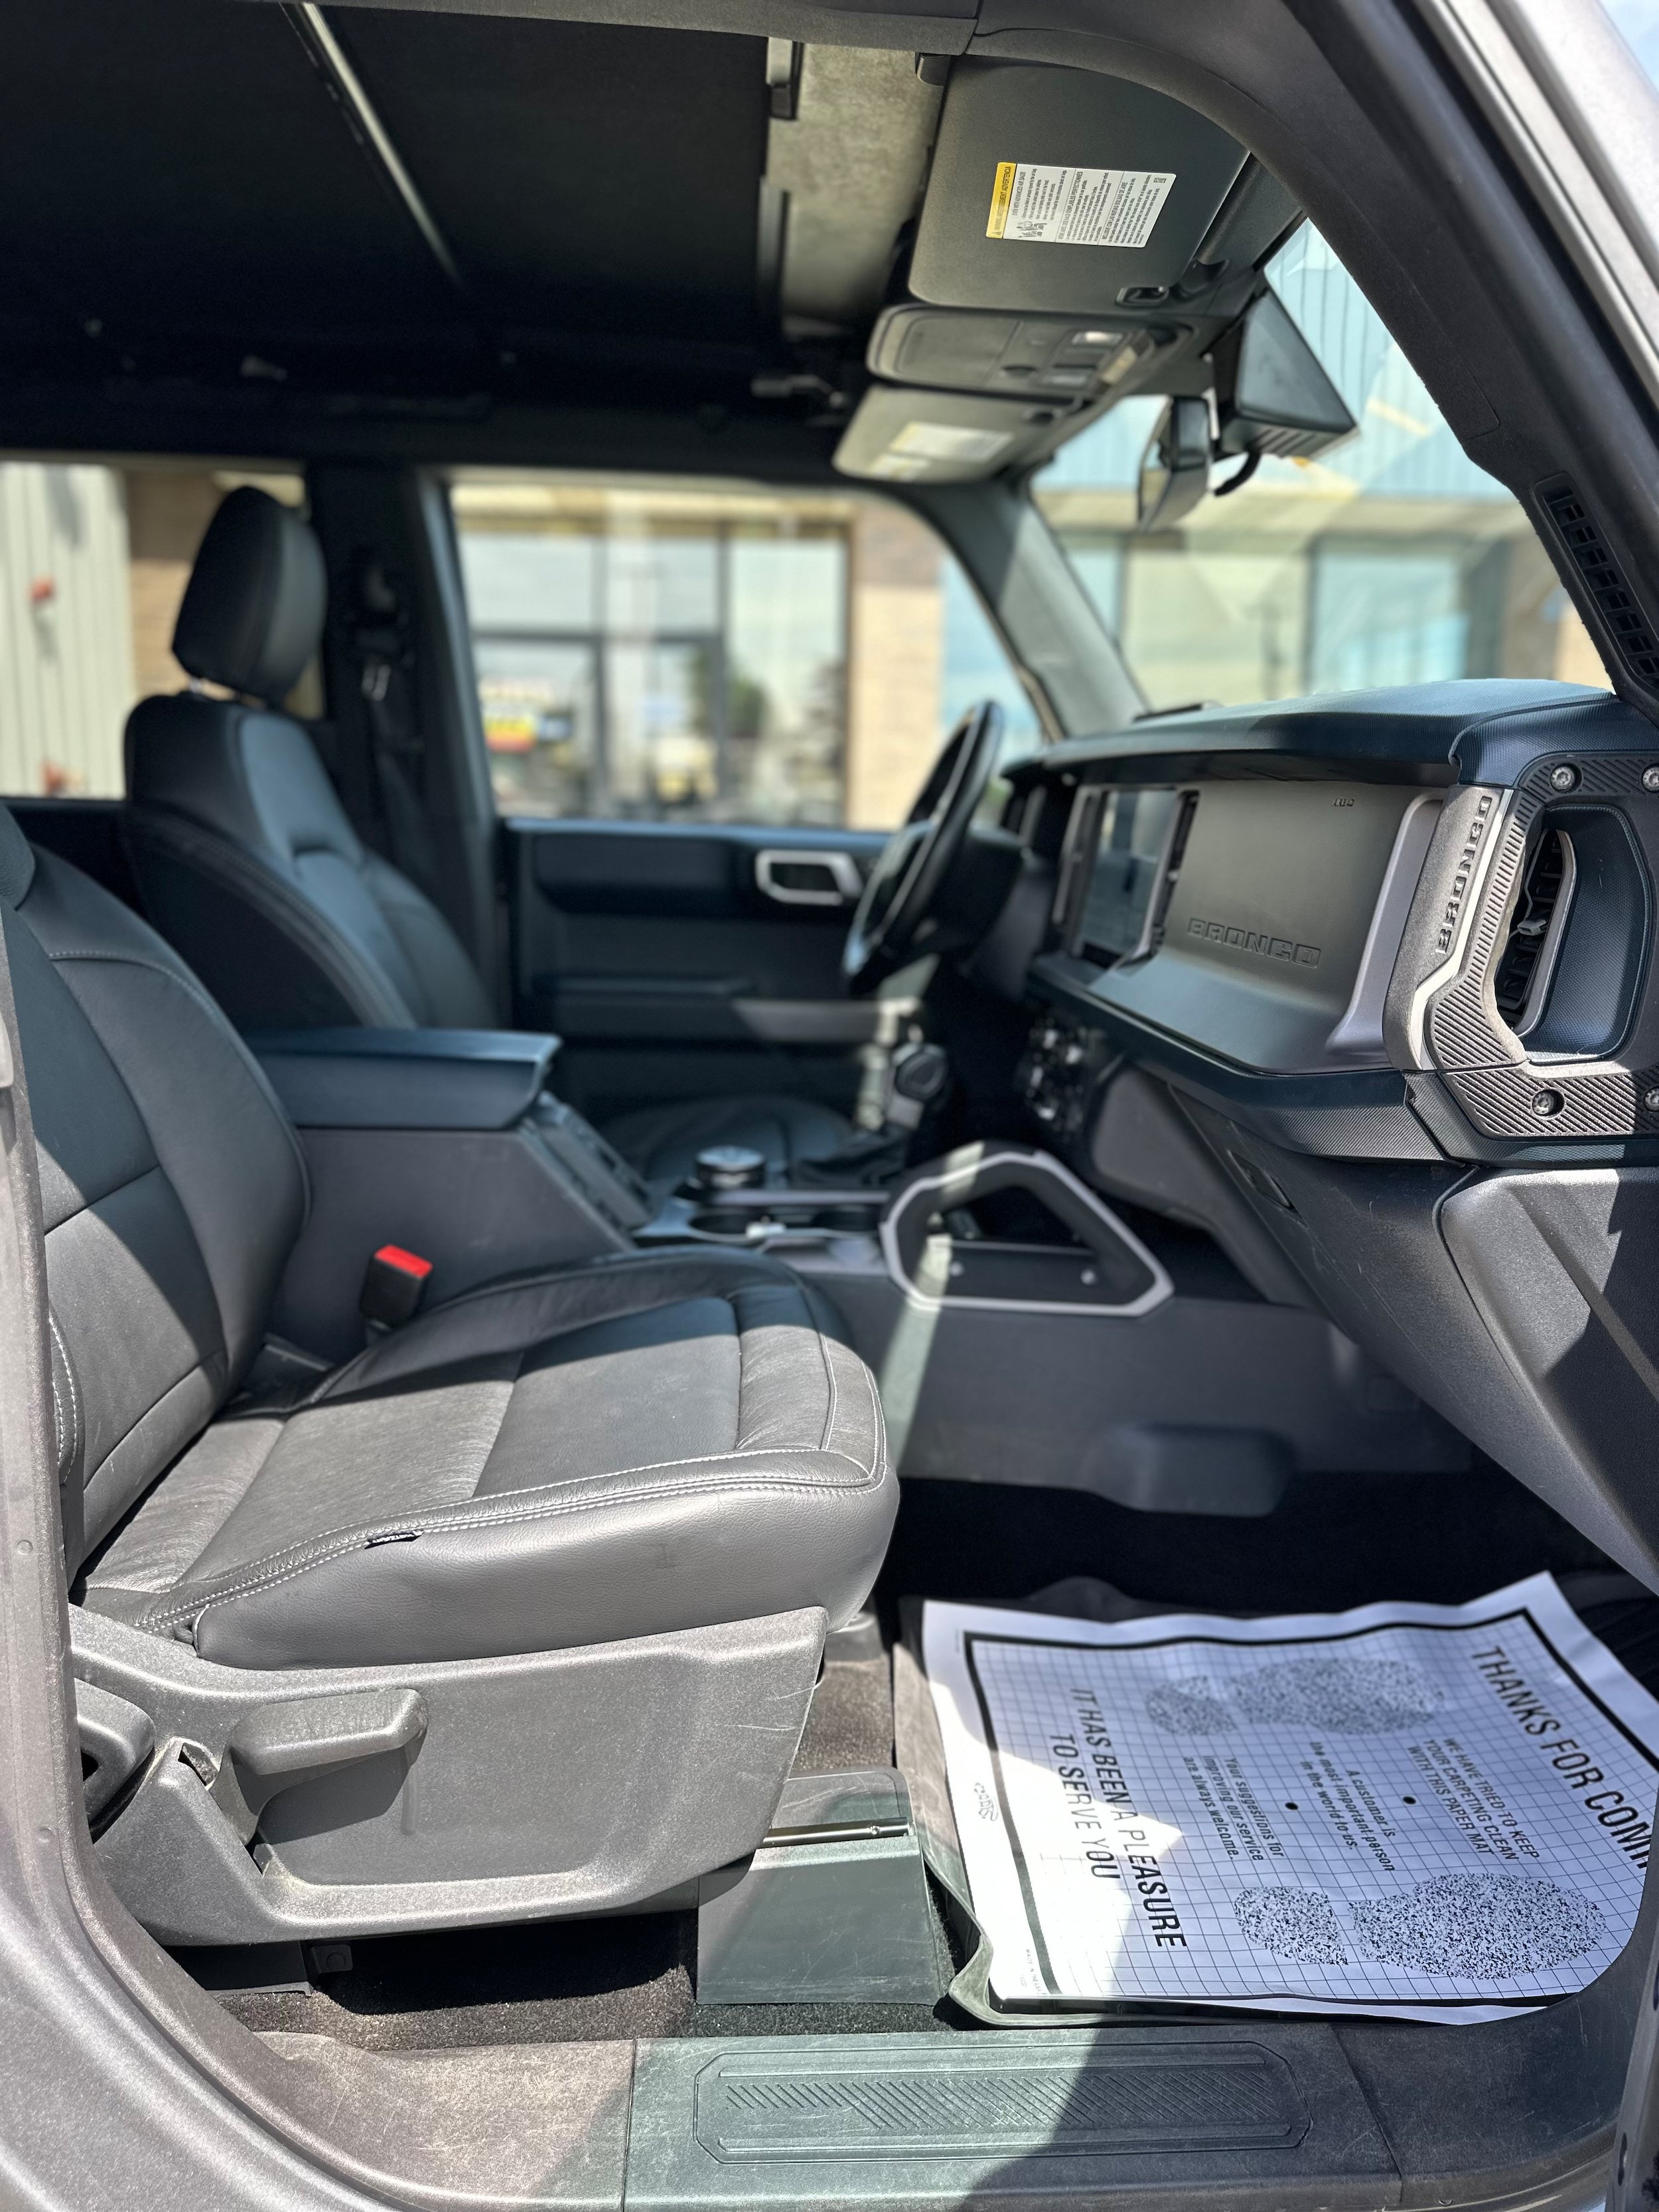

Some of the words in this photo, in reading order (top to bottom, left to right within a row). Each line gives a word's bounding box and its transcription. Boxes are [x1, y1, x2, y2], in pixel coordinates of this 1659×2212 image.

[1435, 796, 1492, 954] BRONCO
[1187, 917, 1321, 969] BRONCO
[1070, 1688, 1098, 1705] IT
[1050, 1733, 1080, 1757] TO
[1078, 1709, 1112, 1747] HAS
[1443, 1738, 1465, 1753] WE
[1091, 1753, 1133, 1803] BEEN
[1453, 1755, 1484, 1779] HAVE
[1471, 1646, 1561, 1735] THANKS
[1540, 1739, 1605, 1790] FOR
[1584, 1791, 1652, 1869] COM
[1058, 1766, 1102, 1829] SERVE
[1111, 1810, 1138, 1820] A
[1184, 1757, 1200, 1771] are
[1192, 1775, 1216, 1807] always
[1209, 1810, 1239, 1860] welcome.
[1202, 1755, 1234, 1802] improving
[1227, 1805, 1244, 1820] our
[1236, 1823, 1264, 1860] service
[1224, 1758, 1244, 1779] Your
[1236, 1781, 1275, 1839] suggestions
[1267, 1842, 1285, 1856] for
[1300, 1761, 1313, 1770] in
[1307, 1773, 1323, 1787] the
[1317, 1791, 1344, 1818] world
[1334, 1822, 1349, 1831] to
[1342, 1834, 1358, 1850] us.
[1309, 1741, 1325, 1756] the
[1319, 1759, 1343, 1781] most
[1334, 1785, 1374, 1833] important
[1362, 1836, 1396, 1871] person
[1352, 1779, 1389, 1826] customer
[1382, 1828, 1396, 1837] is
[1407, 1746, 1435, 1771] WITH
[1425, 1773, 1451, 1795] THIS
[1442, 1797, 1475, 1830] PAPER
[1467, 1833, 1494, 1855] MAT
[1423, 1739, 1451, 1765] YOUR
[1443, 1767, 1492, 1822] CARPETING
[1484, 1826, 1520, 1860] CLEAN
[1475, 1781, 1506, 1808] TRIED
[1498, 1812, 1518, 1827] TO
[1081, 1838, 1121, 1879] YOU
[1509, 1830, 1540, 1858] KEEP
[1118, 1830, 1187, 1947] PLEASURE
